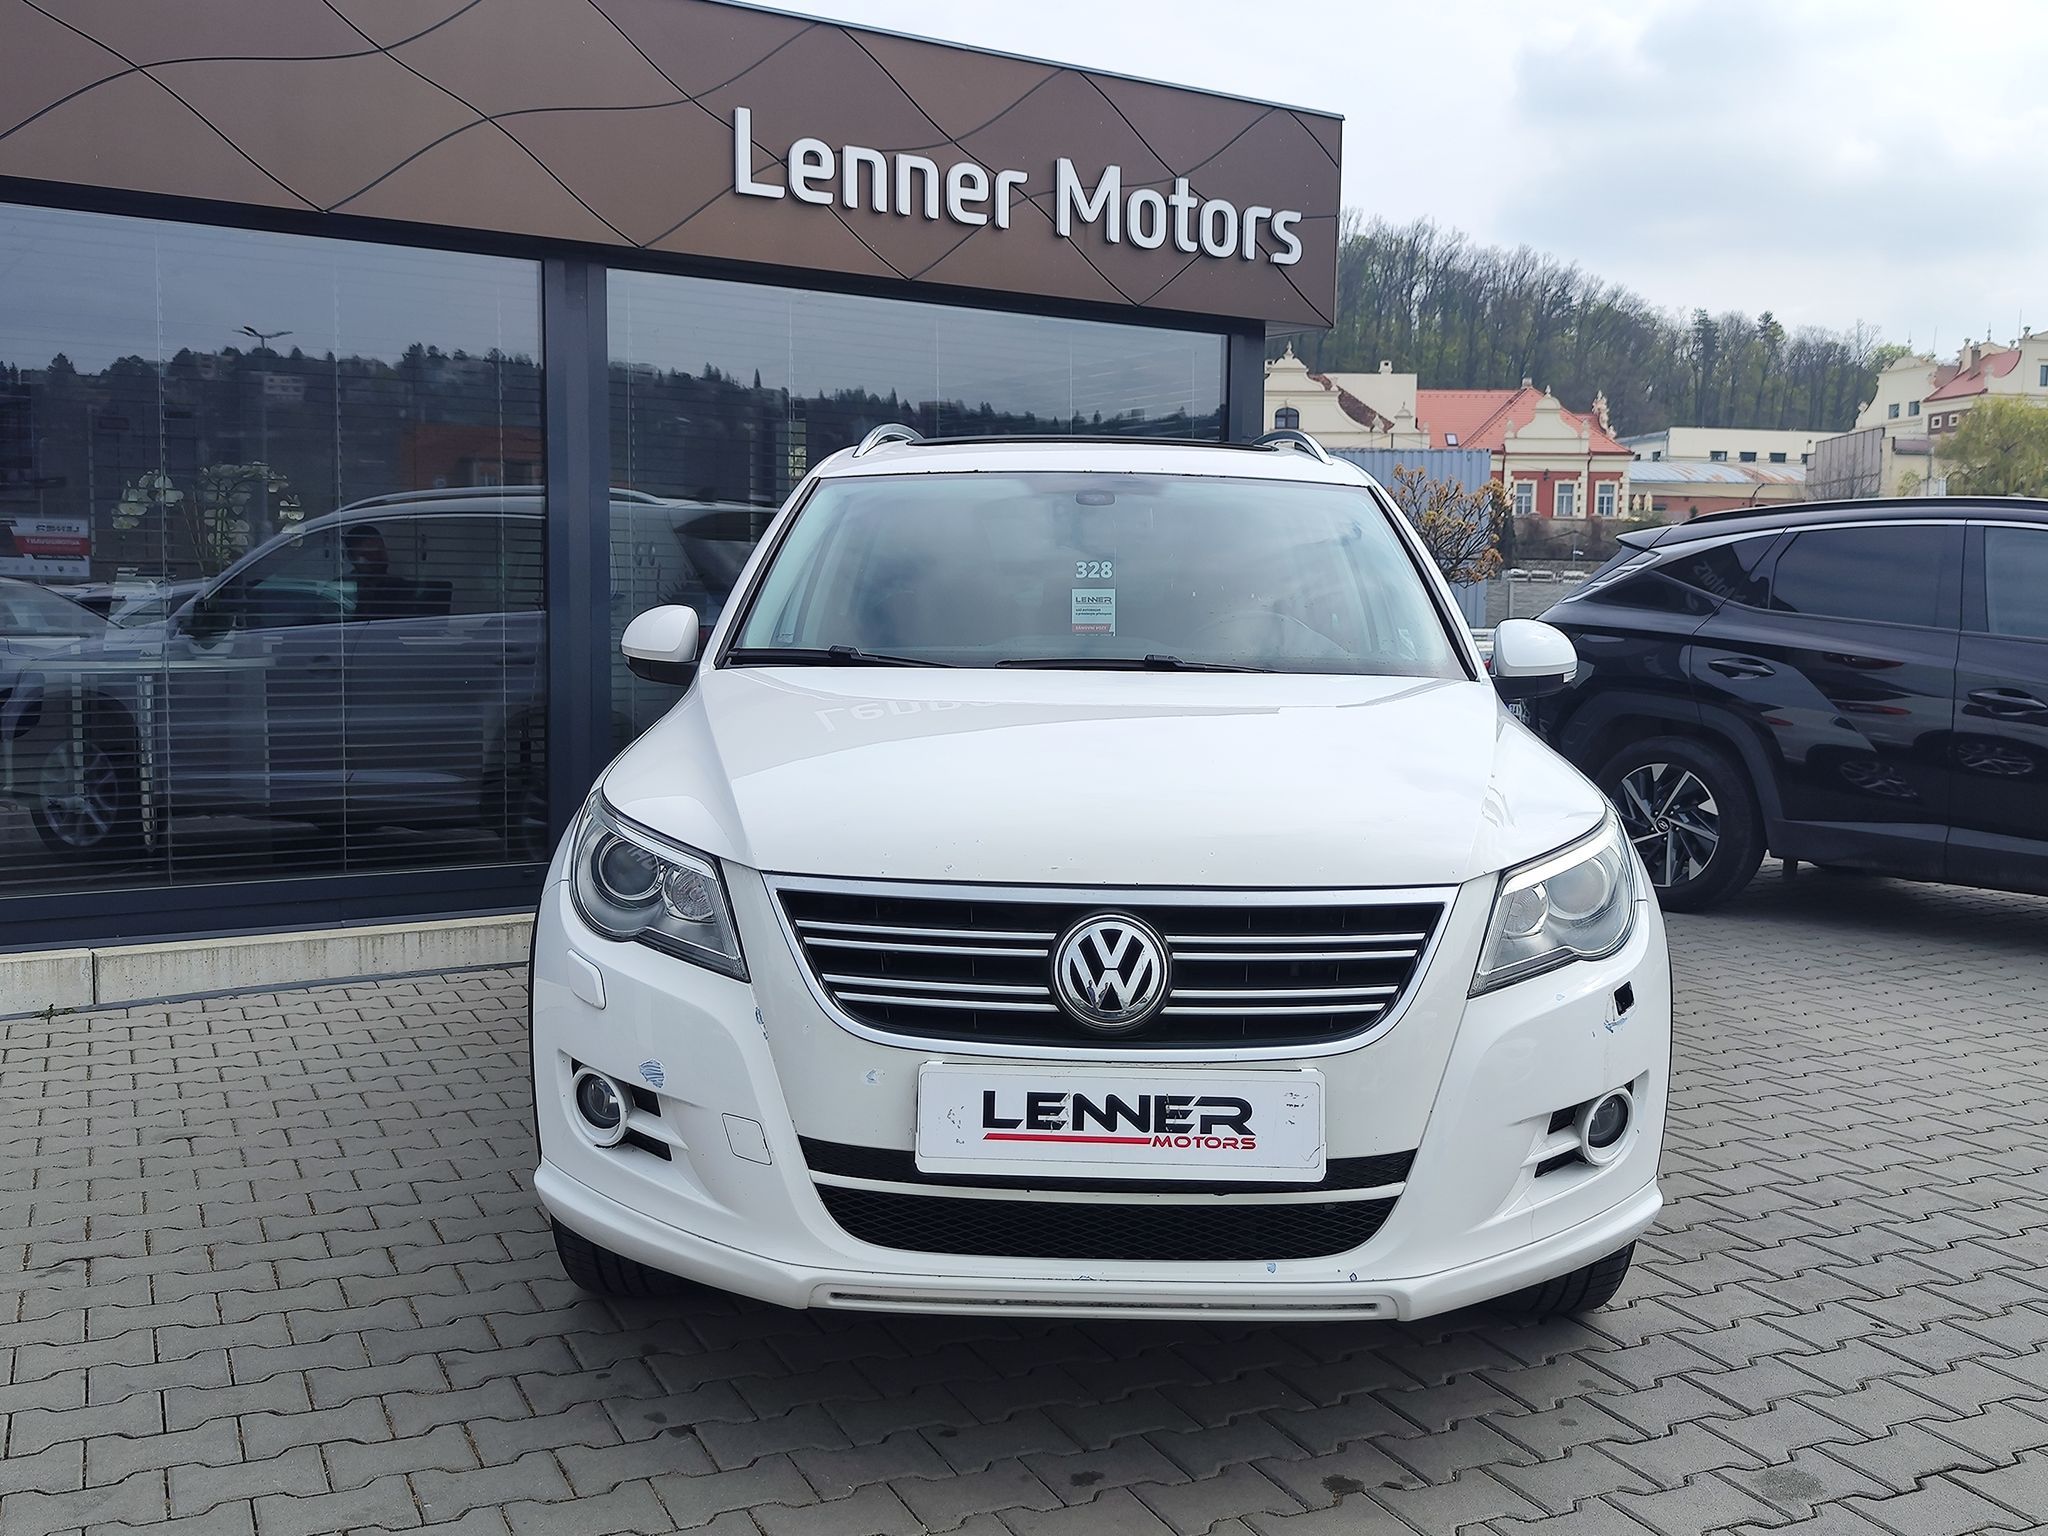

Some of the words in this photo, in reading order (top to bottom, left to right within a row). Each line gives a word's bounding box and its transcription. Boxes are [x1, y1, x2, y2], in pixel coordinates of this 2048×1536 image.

[734, 106, 1029, 230] Lenner
[1055, 157, 1303, 266] Motors
[1075, 560, 1113, 579] 328
[1075, 596, 1113, 605] LENNER
[1060, 920, 1161, 1019] VW
[982, 1090, 1257, 1136] LENNER
[1152, 1134, 1257, 1150] MOTORS
